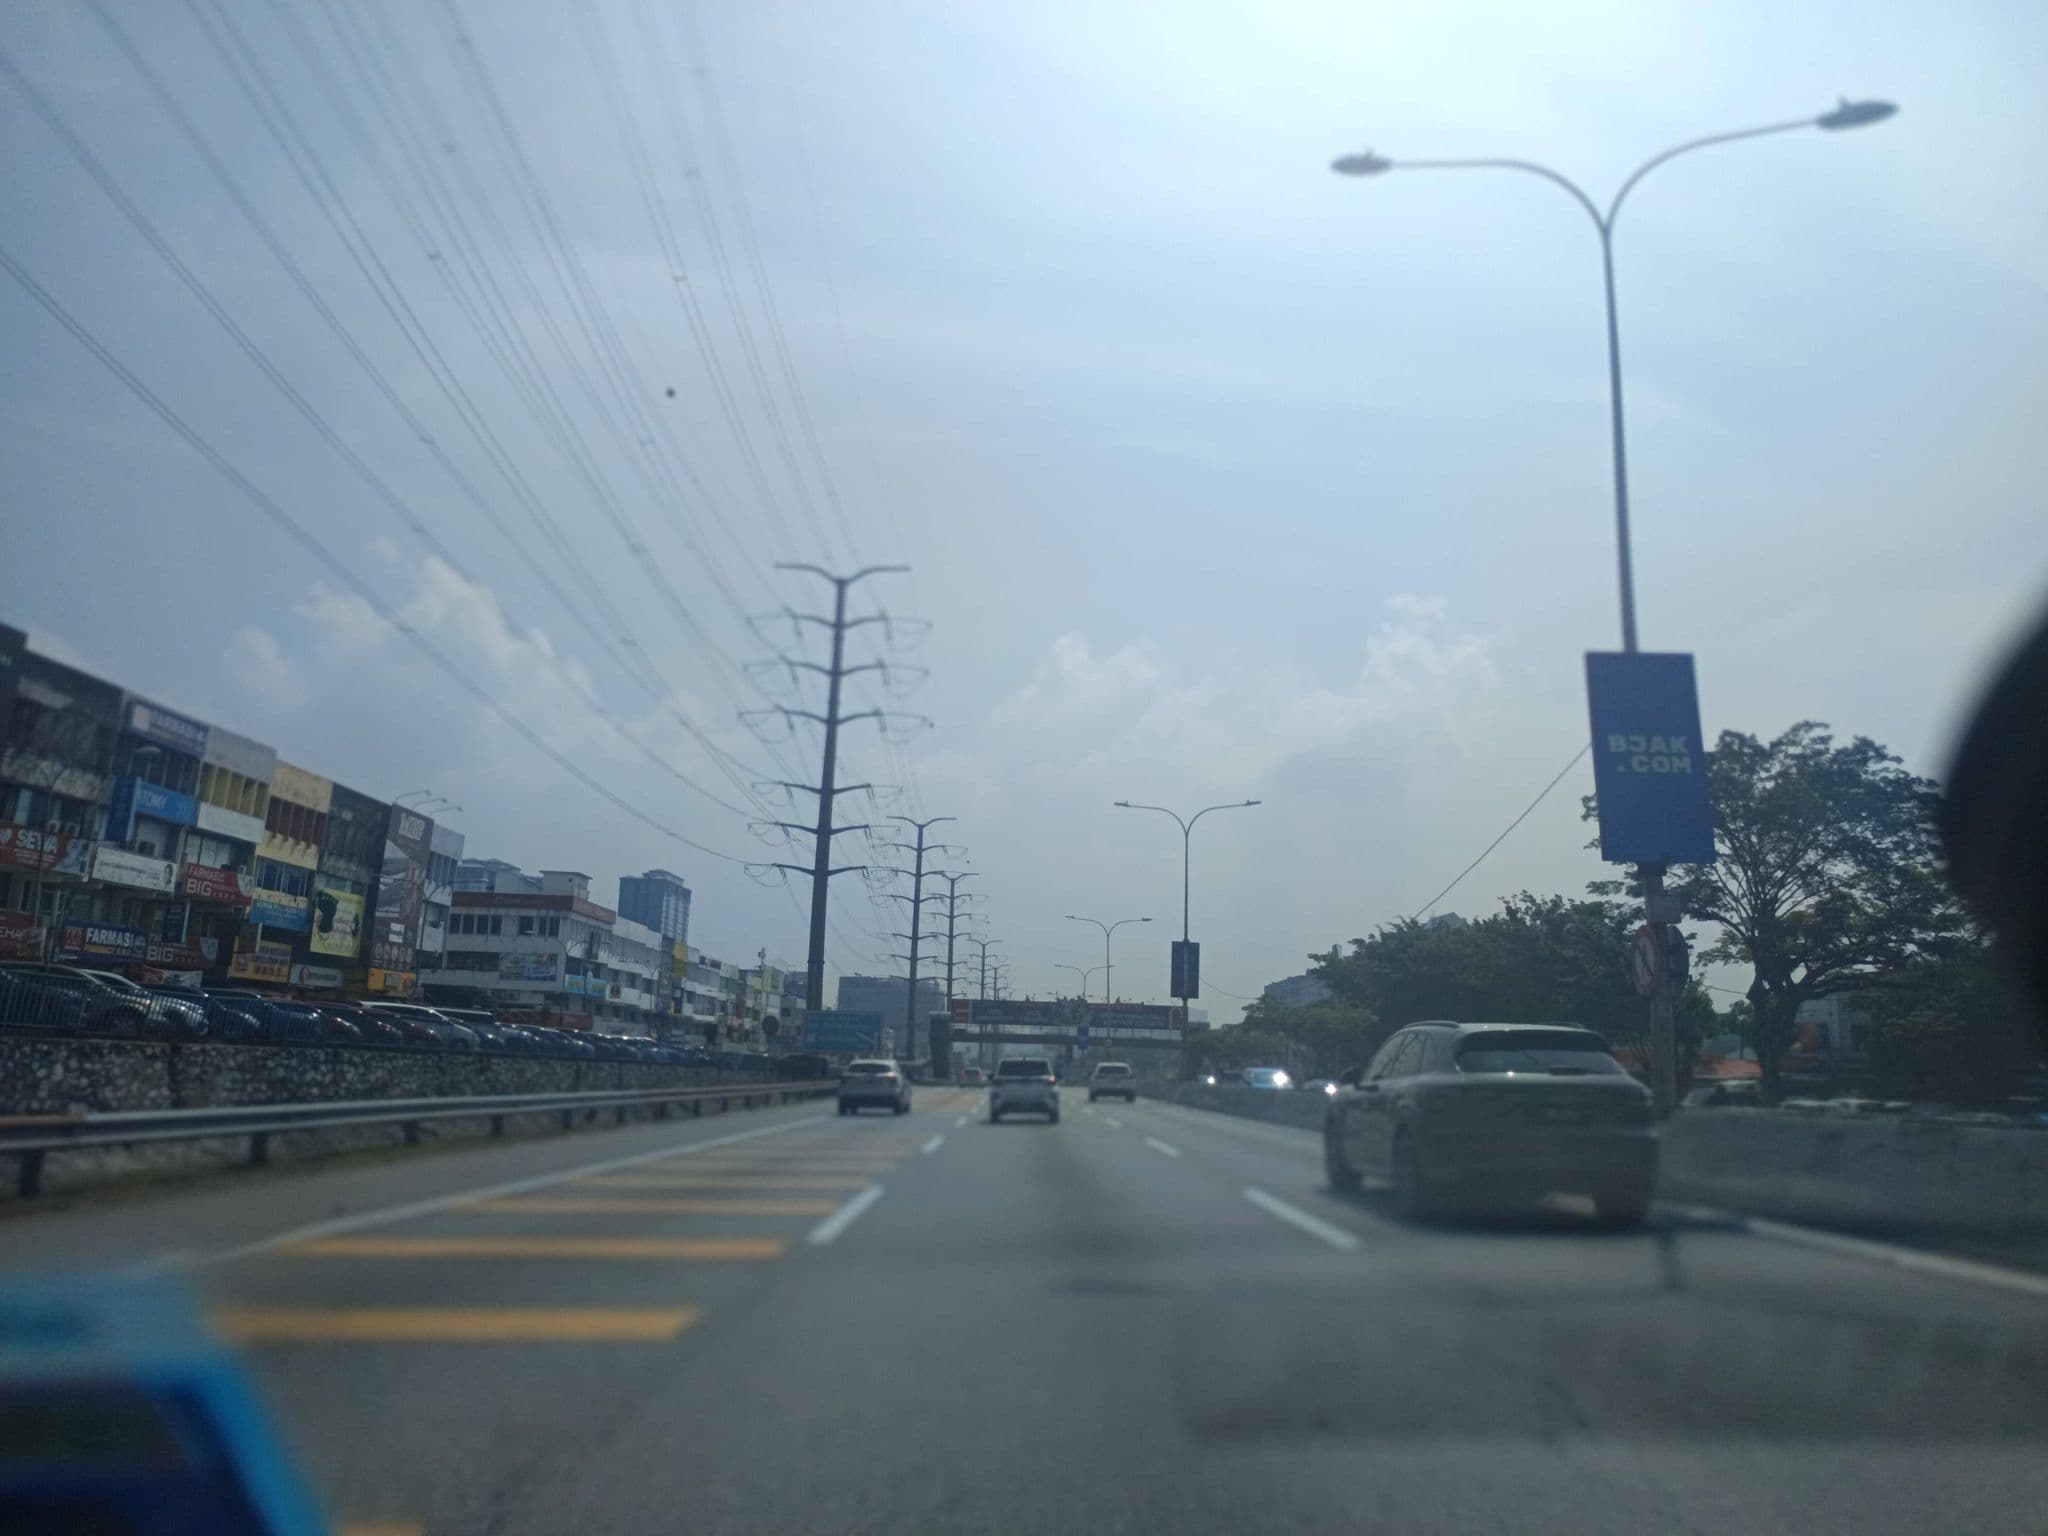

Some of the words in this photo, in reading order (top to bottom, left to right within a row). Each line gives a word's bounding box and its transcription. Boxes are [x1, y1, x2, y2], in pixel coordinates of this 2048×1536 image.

[1608, 735, 1688, 753] BJAK
[1616, 754, 1692, 775] .COM
[186, 878, 212, 896] BIG
[86, 927, 135, 948] FARMASI
[147, 945, 174, 962] BIG
